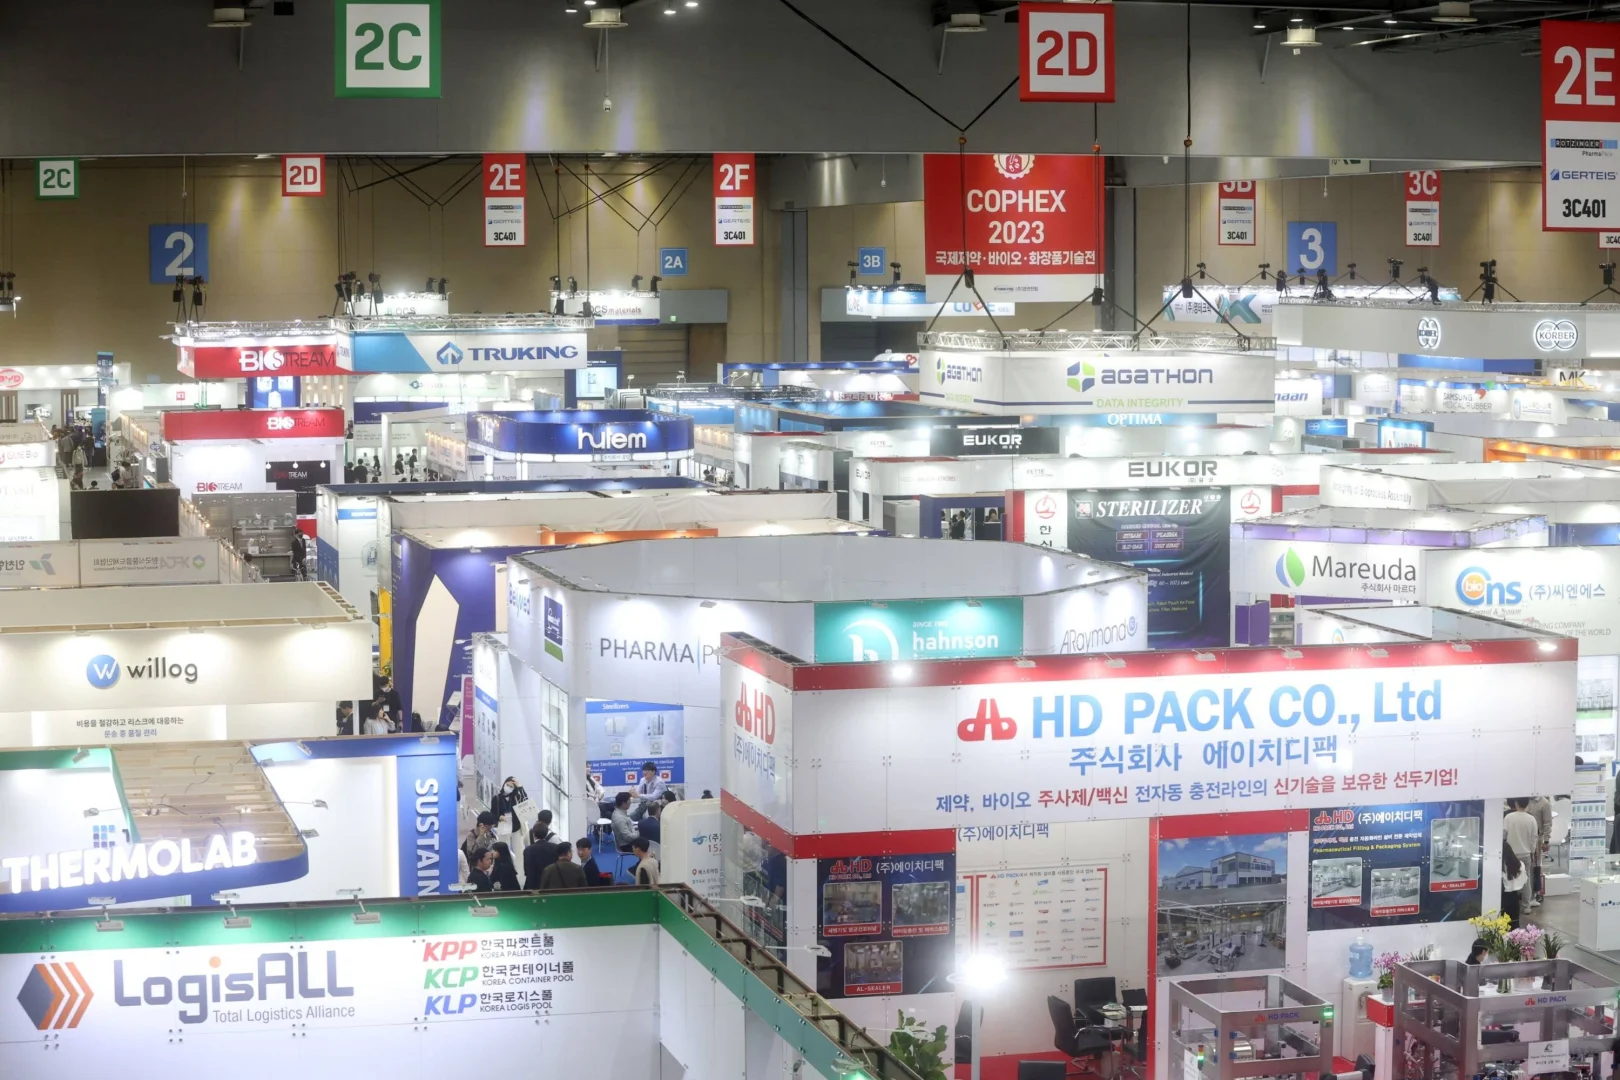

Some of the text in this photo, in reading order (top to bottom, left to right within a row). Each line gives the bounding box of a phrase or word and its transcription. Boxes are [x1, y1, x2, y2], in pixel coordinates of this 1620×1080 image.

[355, 22, 422, 71] 2C
[1037, 30, 1098, 76] 2D
[1554, 45, 1616, 106] 2E
[42, 169, 72, 190] 2C
[289, 165, 318, 186] 2D
[489, 164, 521, 191] 2E
[719, 163, 750, 191] 2F
[1409, 170, 1437, 196] 3C
[1562, 171, 1616, 180] GERTEIS
[967, 189, 1067, 213] COPHEX
[1562, 198, 1607, 218] 3C401
[493, 232, 516, 241] 3C401
[723, 231, 746, 240] 3C401
[988, 220, 1045, 244] 2023
[1227, 231, 1247, 240] 3C401
[1413, 232, 1432, 242] 3C401
[164, 231, 194, 276] 2
[1300, 228, 1325, 270] 3
[664, 256, 683, 269] 2A
[863, 255, 881, 268] 3B
[1539, 328, 1575, 340] KÖRBER
[468, 345, 578, 361] TRUKING
[1096, 397, 1184, 408] DATA INTEGRITY
[1443, 392, 1473, 402] SAMSUNG
[1467, 402, 1492, 410] RUBBER
[1108, 413, 1162, 425] OPTIMA
[962, 434, 1022, 446] EUKOR
[1128, 460, 1218, 478] EUKOR
[1388, 490, 1412, 506] Assembly
[1096, 498, 1203, 518] STERILIZER
[1312, 555, 1417, 581] Mareuda
[1361, 582, 1417, 594] 주식회사 마르다
[1529, 584, 1606, 600] (주)씨엔에스
[912, 630, 999, 650] hahnson
[1588, 628, 1612, 636] WORLD
[600, 638, 694, 664] PHARMA
[126, 657, 198, 684] willog
[754, 688, 776, 746] HD
[1032, 679, 1443, 739] HD PACK CO., Ltd
[76, 716, 184, 728] 비용을 절감하고 리스크에 대응하는
[128, 729, 142, 738] 품질
[144, 728, 157, 737] 관리
[734, 732, 776, 784] (주)에이치디팩
[1068, 735, 1338, 777] 주식회사 에이치디팩
[936, 767, 1458, 814] 제약, 바이오 주사제/백신 전자동 충전라인의 신기술을 보유한 선두기업!
[1332, 810, 1354, 824] HD
[1358, 809, 1424, 825] (주)에이치디팩
[957, 823, 1050, 842] (주)에이치디팩
[1353, 844, 1369, 852] Filling
[1402, 842, 1420, 850] System
[3, 830, 257, 894] THERMOLAB
[850, 859, 872, 873] HD
[876, 860, 944, 874] (주)에이치디팩
[423, 940, 478, 962] KPP
[481, 936, 554, 951] 한국파렛트풀
[481, 948, 554, 959] KOREA PALLET POOL
[424, 966, 479, 989] KCP
[482, 961, 574, 978] 한국컨테이너풀
[113, 950, 354, 1024] LogisALL
[482, 974, 574, 986] KOREA CONTAINER POOL
[424, 993, 477, 1016] KLP
[480, 990, 553, 1004] 한국로지스풀
[213, 1005, 355, 1023] Total Logistics Alliance
[480, 1002, 553, 1012] KOREA LOGIS POOL
